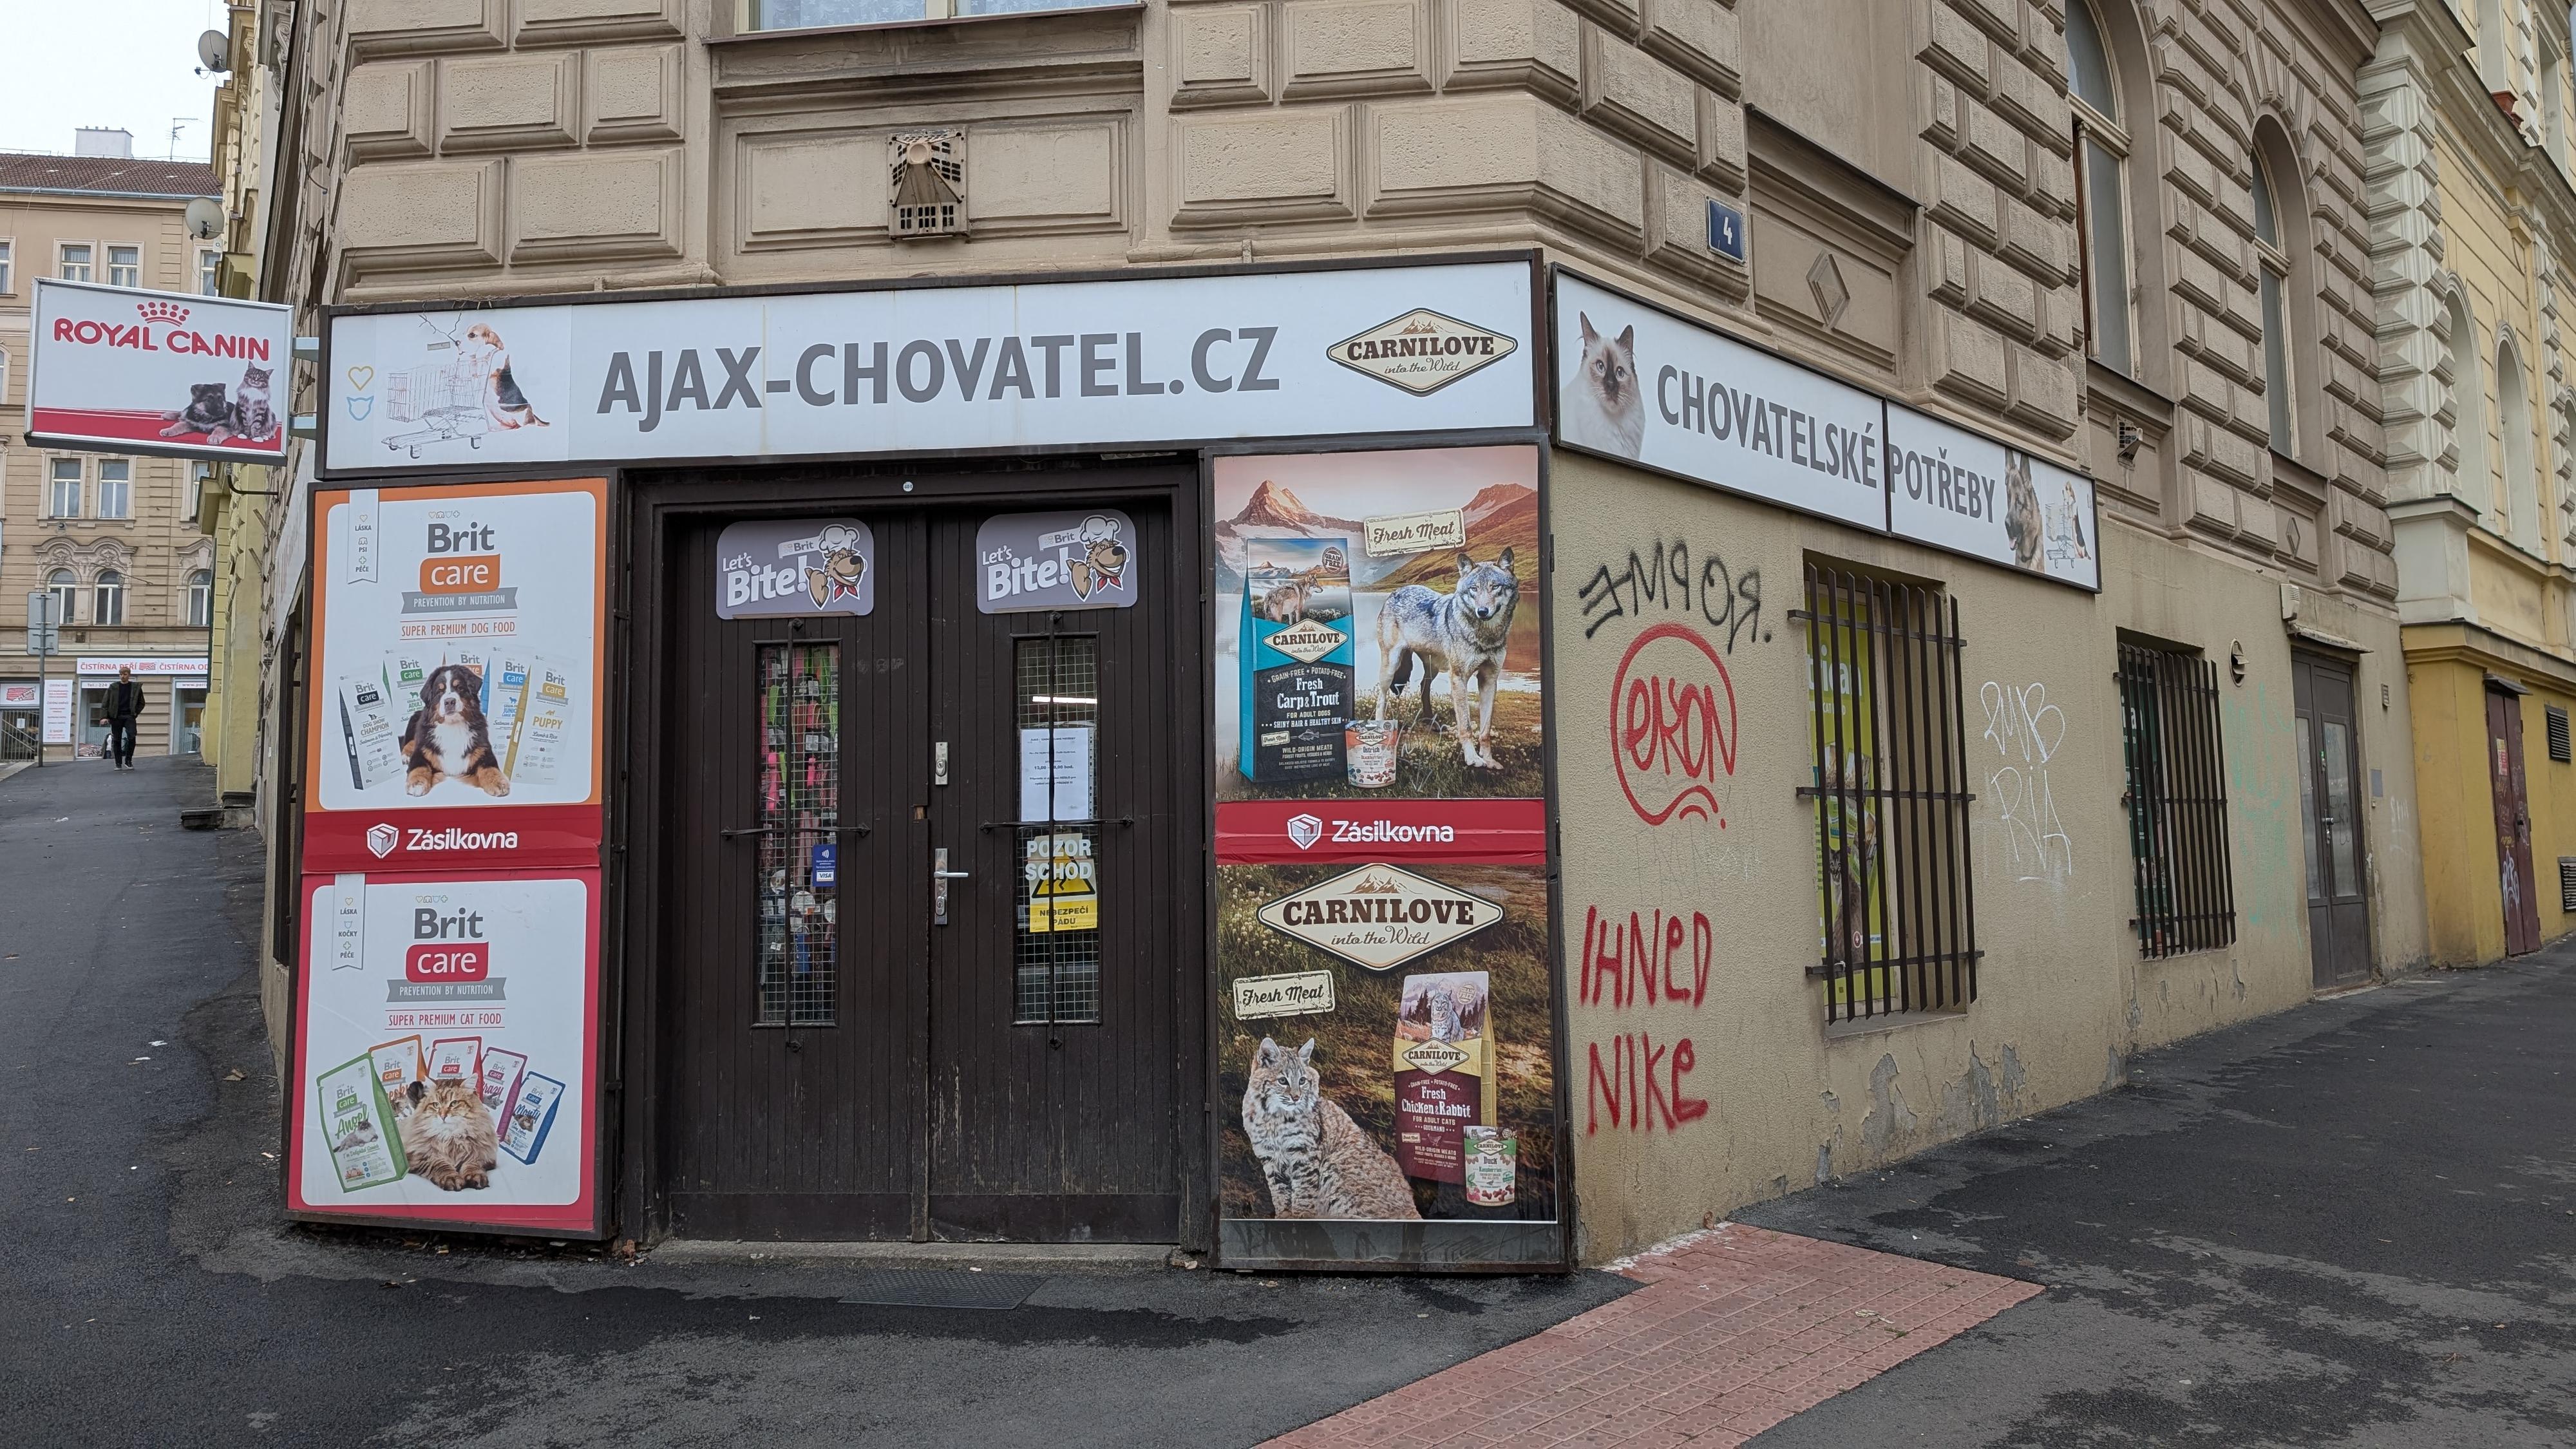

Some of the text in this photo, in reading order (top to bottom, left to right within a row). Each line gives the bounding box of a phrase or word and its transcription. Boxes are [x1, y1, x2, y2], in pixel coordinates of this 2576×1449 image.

[1723, 216, 1732, 245] 4
[54, 317, 270, 361] ROYAL CANIN
[1347, 336, 1494, 361] CARNILOVE
[1385, 357, 1461, 374] into the Wild
[596, 326, 1280, 433] AJAX-CHOVATEL.CZ
[1657, 364, 1996, 524] CHOVATELSKÉ POTŘEBY
[355, 523, 372, 531] LÁSKA
[1373, 520, 1455, 544] Fresh Meat
[428, 521, 495, 553] Brit
[1054, 531, 1074, 544] Brit
[793, 540, 814, 552] Brit
[723, 553, 752, 572] Let's
[982, 546, 1012, 565] Let's
[355, 564, 370, 573] PÉČE
[431, 563, 489, 586] care
[987, 547, 1068, 601] Bite!
[726, 555, 807, 607] Bite!
[413, 594, 506, 608] PREVENTION BY NUTRITION
[401, 621, 515, 637] SUPER PREMIUM DOG FOOD
[1273, 632, 1340, 646] CARNILOVE
[80, 662, 117, 670] ČISTÍRNA
[400, 659, 420, 669] Brit
[460, 654, 480, 664] Brit
[506, 661, 525, 673] Brit
[404, 670, 421, 679] care
[506, 674, 523, 683] care
[545, 671, 565, 685] Brit
[1271, 667, 1344, 683] GRAIN-FREE POTATO-FREE
[355, 683, 375, 694] Brit
[1296, 677, 1323, 690] Fresh
[361, 693, 376, 702] care
[546, 686, 562, 696] care
[361, 722, 390, 736] CHAMPION
[363, 721, 372, 729] DOG
[533, 716, 563, 730] PUPPY
[1309, 718, 1331, 726] HEALTHY
[1332, 820, 1454, 843] Zásilkovna
[406, 828, 518, 851] Zásilkovna
[1027, 839, 1092, 857] POZOR
[1025, 862, 1092, 880] SCHOD
[340, 906, 357, 915] LÁSKA
[1283, 898, 1474, 926] CARNILOVE
[414, 907, 484, 940] Brit
[338, 929, 357, 938] KOČKY
[1331, 925, 1430, 946] into the Wild
[340, 950, 354, 959] PÉČE
[417, 951, 477, 974] care
[399, 985, 493, 997] PREVENTION BY NUTRITION
[1242, 983, 1324, 1007] Fresh Meat
[388, 1013, 501, 1026] SUPER PREMIUM CAT FOOD
[1408, 1051, 1461, 1061] CARNILOVE
[384, 1060, 401, 1070] Brit
[493, 1063, 506, 1073] Brit
[384, 1072, 399, 1080] care
[489, 1070, 502, 1079] care
[336, 1085, 354, 1099] Brit
[483, 1081, 504, 1098] razy
[531, 1088, 544, 1097] Brit
[1421, 1086, 1446, 1100] Fresh
[339, 1097, 355, 1108] care
